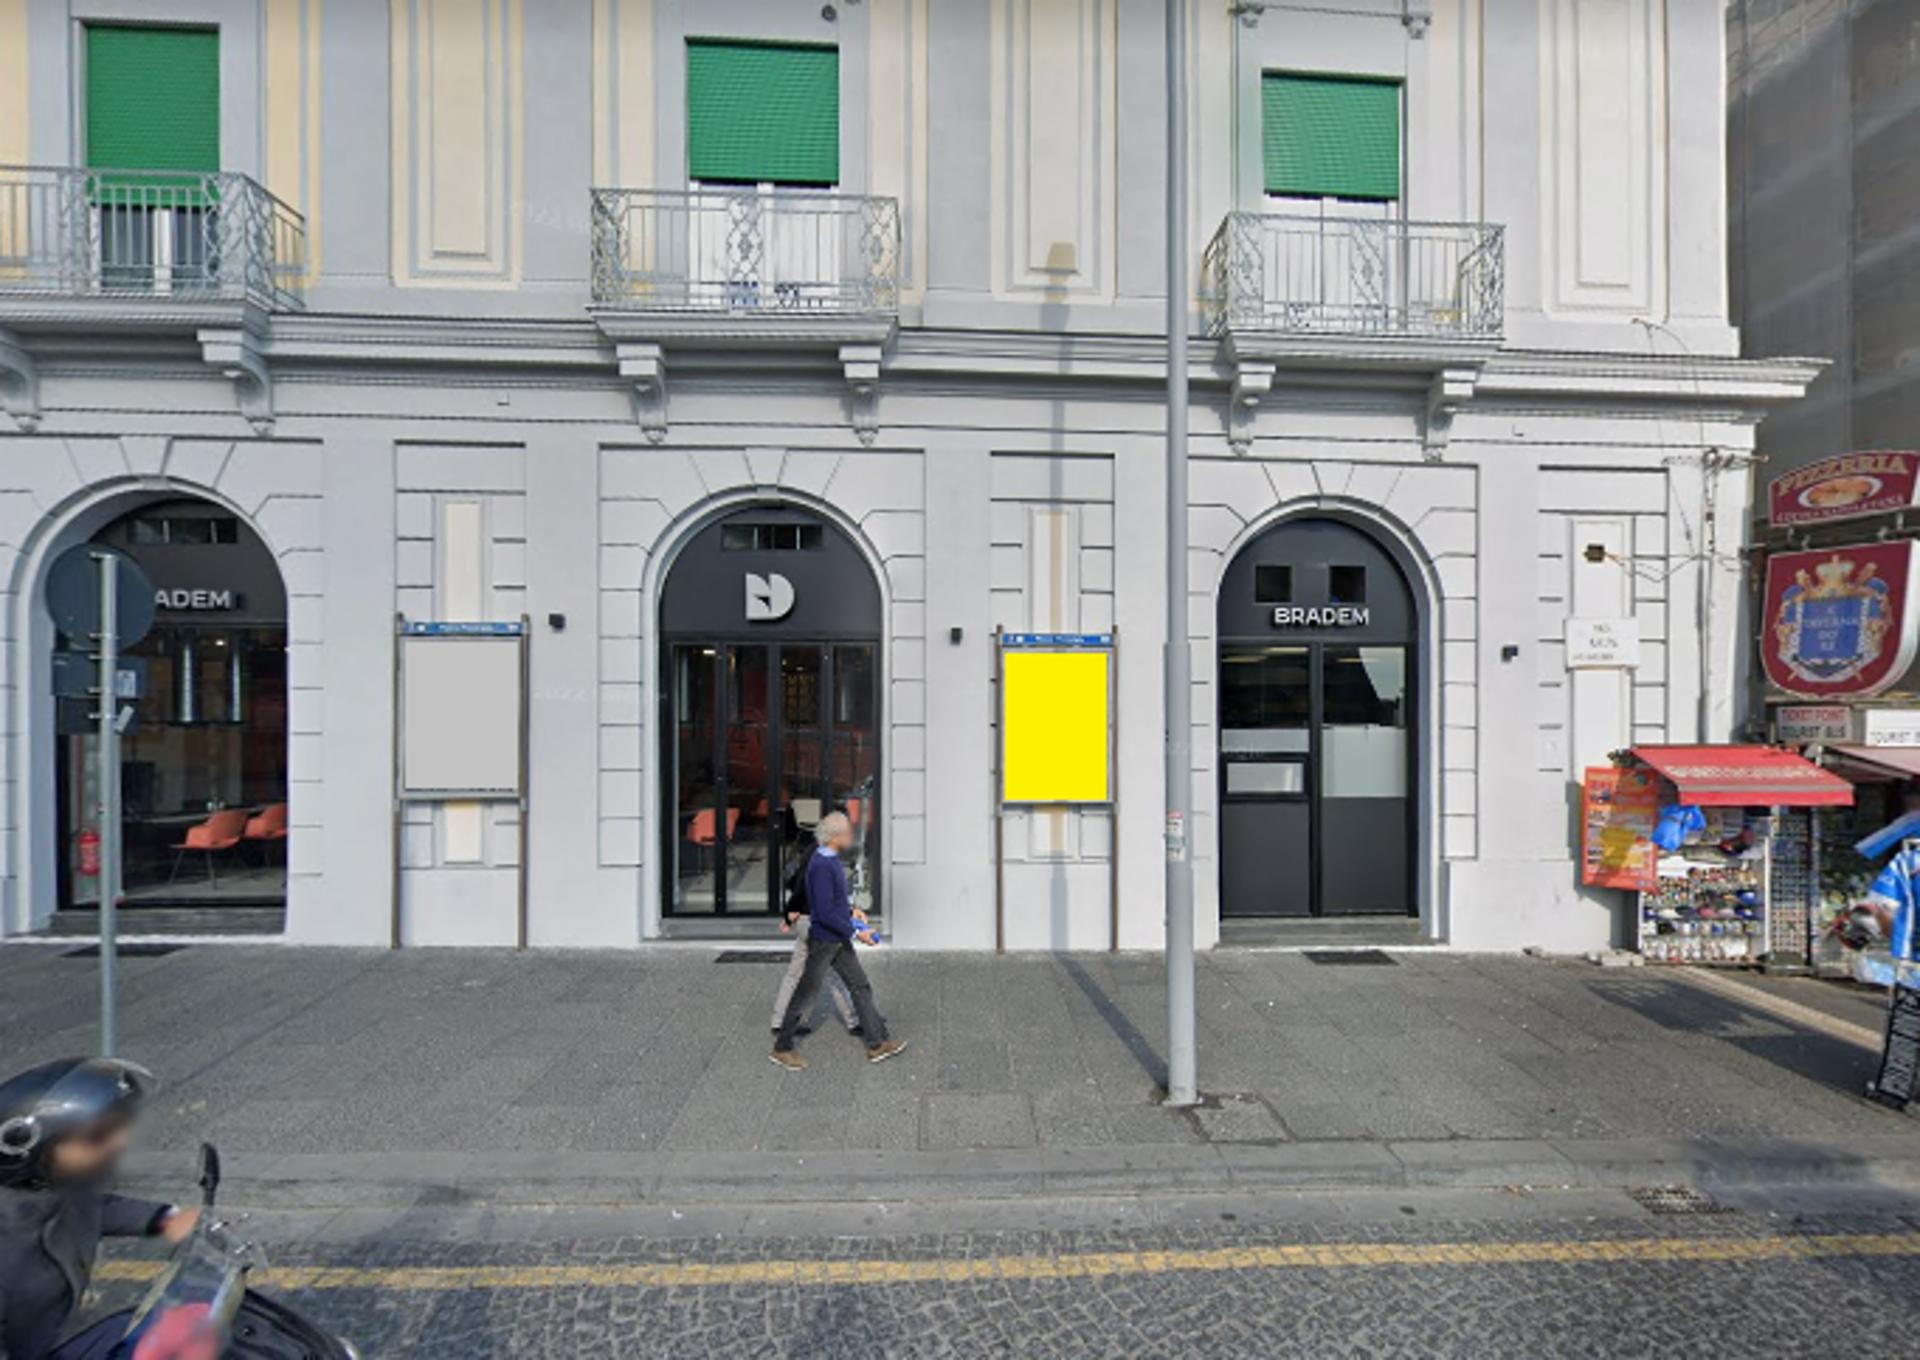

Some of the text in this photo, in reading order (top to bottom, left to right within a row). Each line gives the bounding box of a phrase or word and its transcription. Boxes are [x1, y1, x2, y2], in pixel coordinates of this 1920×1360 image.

[1778, 453, 1909, 496] PIZZERIA
[155, 589, 232, 609] ADEM
[1273, 606, 1370, 626] BRADEM
